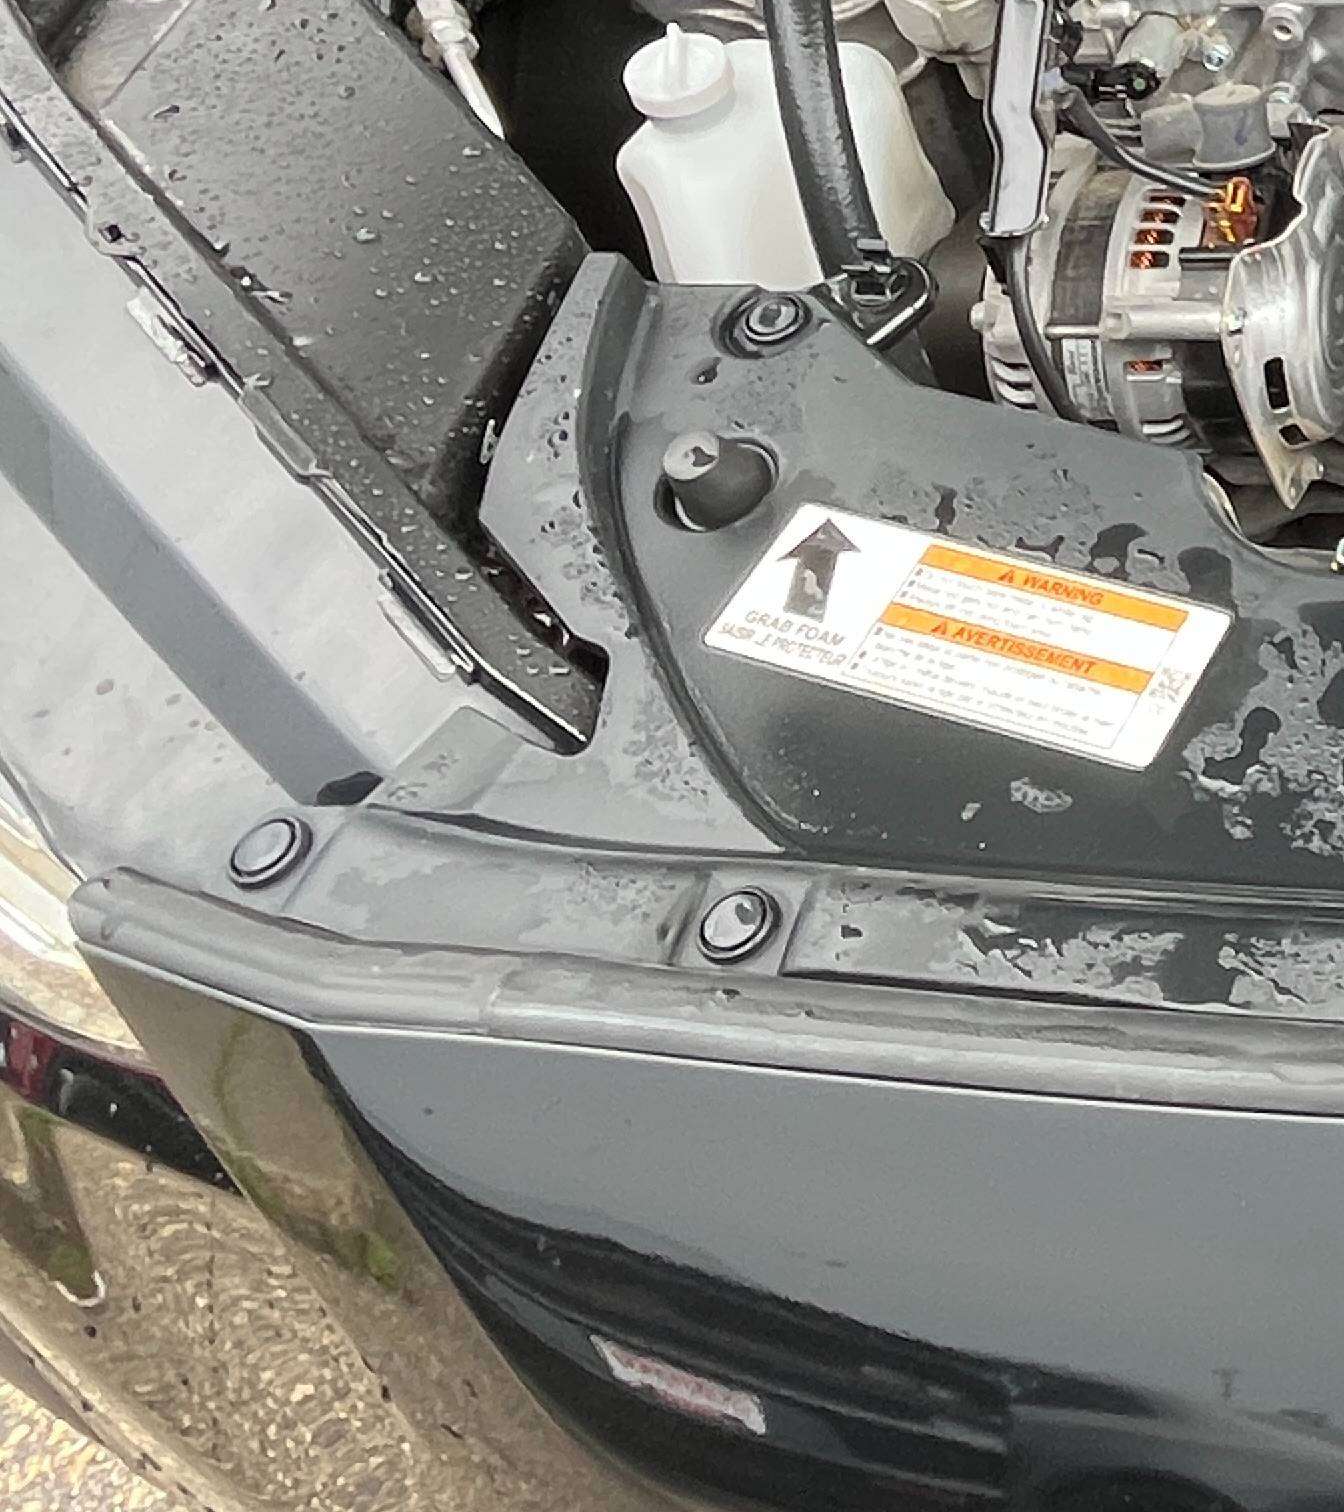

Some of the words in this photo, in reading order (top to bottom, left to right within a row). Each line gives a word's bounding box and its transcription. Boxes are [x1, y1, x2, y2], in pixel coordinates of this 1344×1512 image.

[1024, 575, 1104, 606] WARNING
[744, 609, 794, 634] GRAB
[796, 623, 846, 647] FOAM
[952, 626, 1096, 674] AVERTISSEMENT
